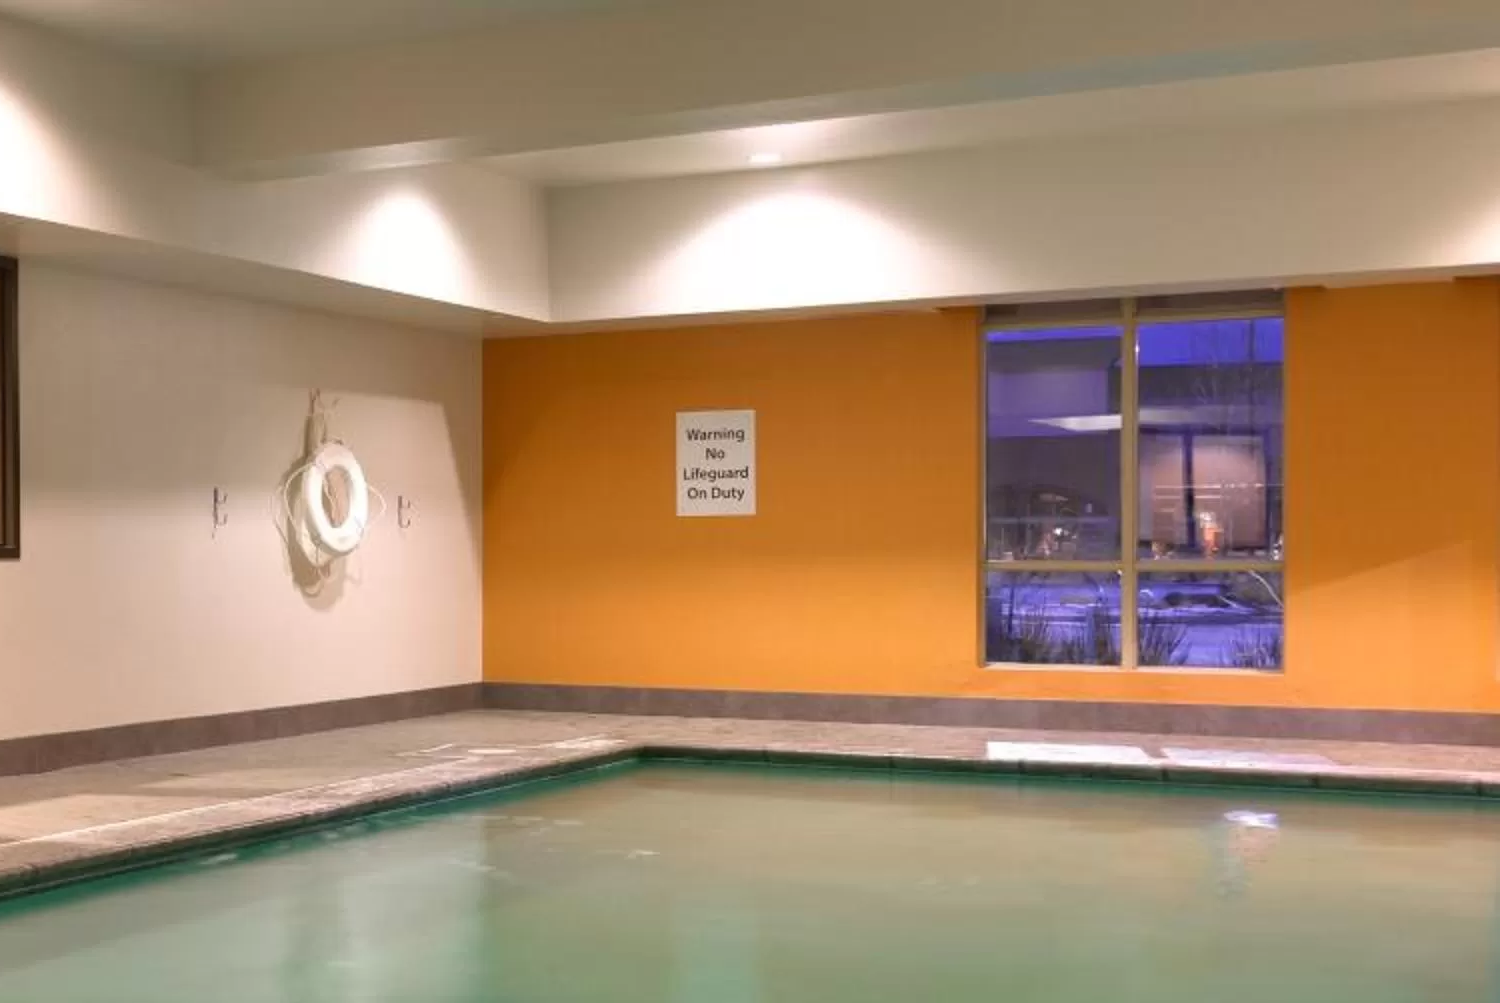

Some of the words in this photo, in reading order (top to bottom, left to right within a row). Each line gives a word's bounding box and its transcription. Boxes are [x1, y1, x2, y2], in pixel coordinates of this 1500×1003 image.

[686, 428, 745, 442] Warning
[705, 448, 725, 460] No
[683, 466, 749, 482] Lifeguard
[687, 487, 707, 499] On
[711, 487, 745, 501] Duty
